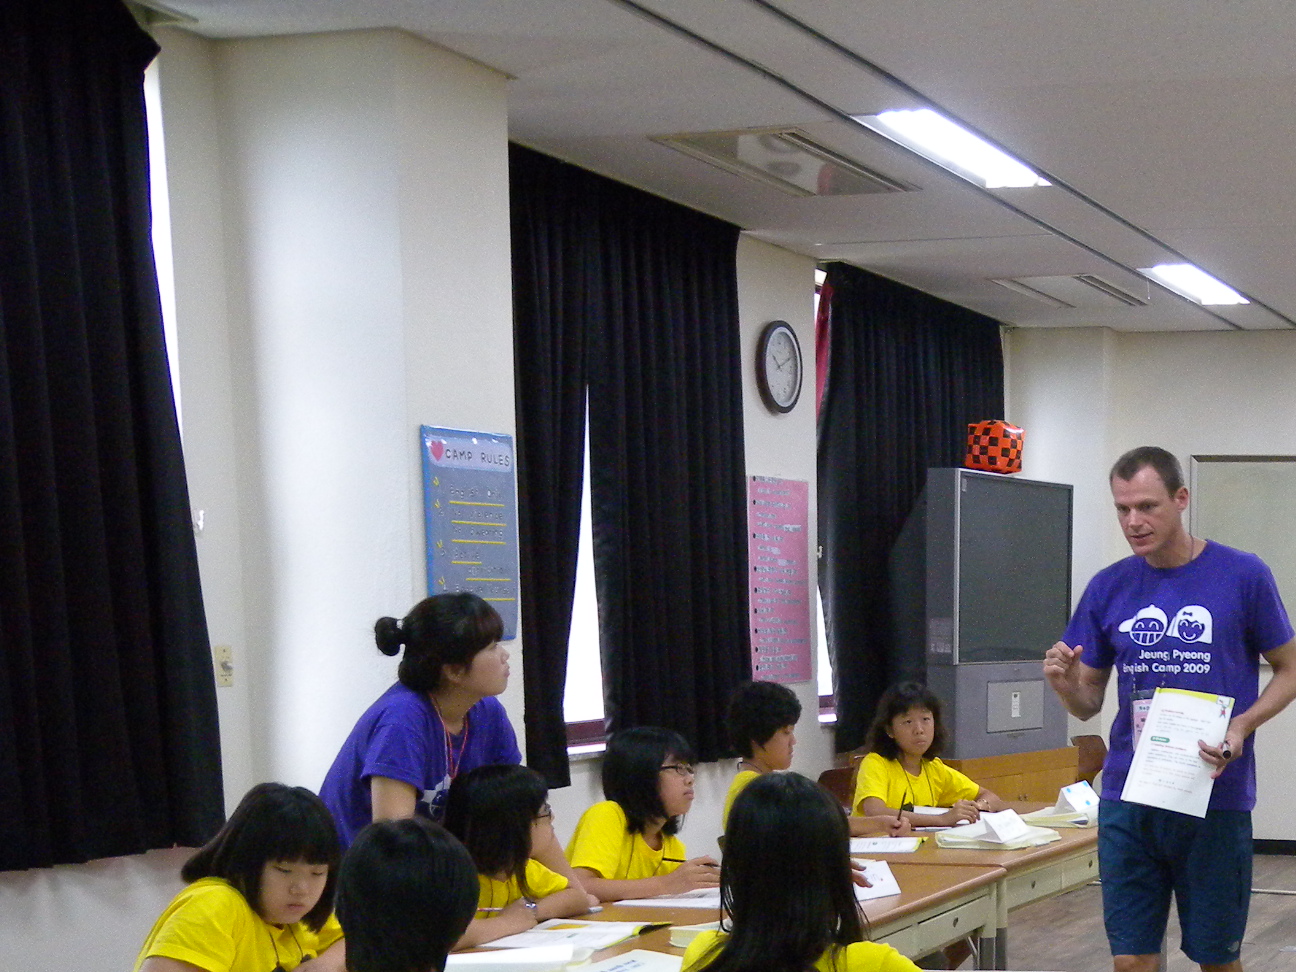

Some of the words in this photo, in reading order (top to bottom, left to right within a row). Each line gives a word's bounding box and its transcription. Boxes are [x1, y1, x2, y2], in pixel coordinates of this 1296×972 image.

[445, 448, 473, 461] CAMP
[481, 452, 511, 467] RULES
[1139, 649, 1170, 662] Jeung
[1173, 649, 1211, 663] Pyeong
[1152, 663, 1181, 675] Camp
[1183, 663, 1211, 674] 2009
